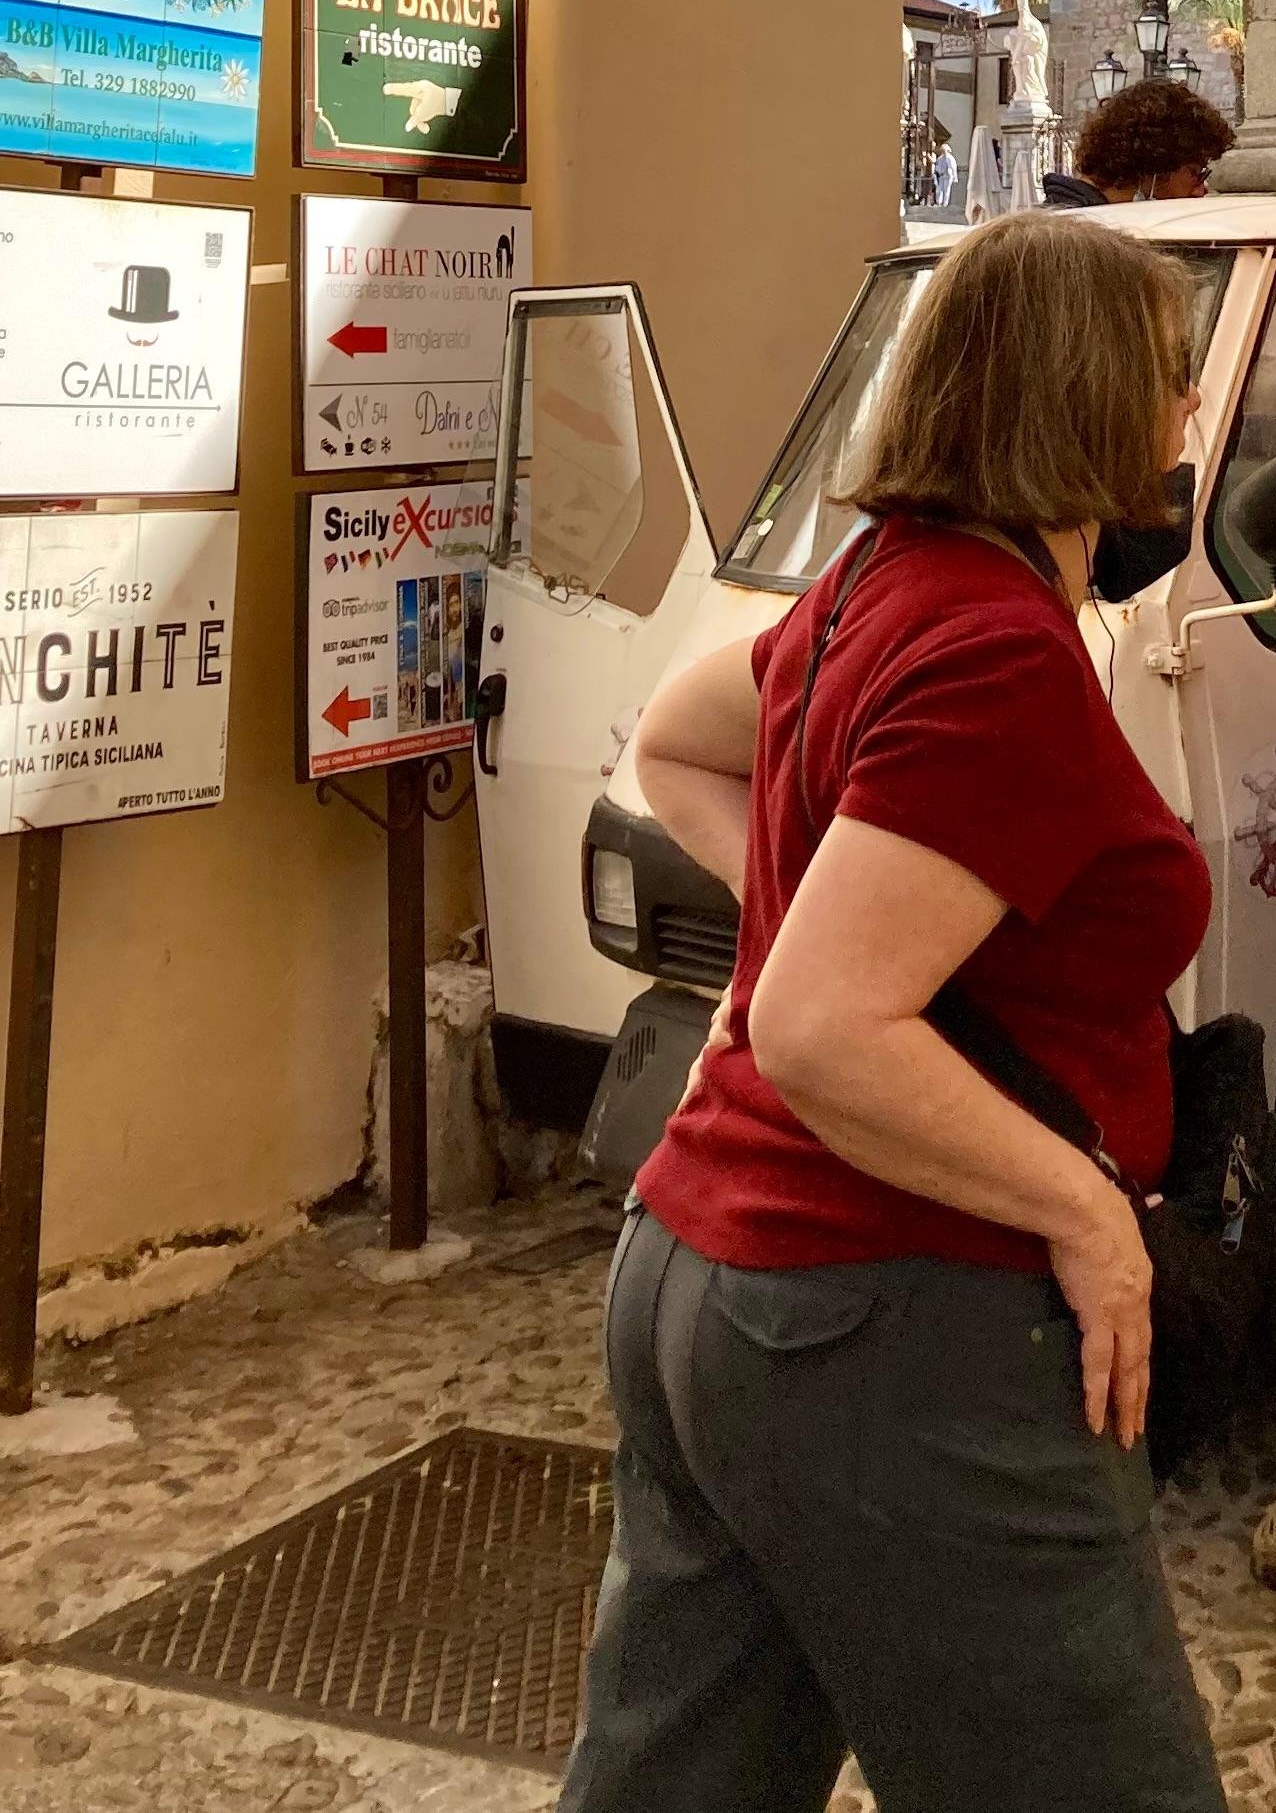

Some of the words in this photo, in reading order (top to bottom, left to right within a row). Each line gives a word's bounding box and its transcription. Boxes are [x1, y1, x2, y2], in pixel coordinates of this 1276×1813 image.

[7, 16, 54, 48] B&B
[61, 25, 109, 57] Villa
[115, 33, 224, 72] Margherita
[358, 22, 483, 69] ristorante
[61, 68, 89, 88] Tel.
[94, 72, 125, 93] 329
[130, 77, 196, 102] 1882990
[0, 109, 199, 148] ww.villamargheritacefalu.it
[325, 245, 357, 275] LE
[365, 247, 428, 277] CHAT
[435, 250, 492, 279] NOIR
[61, 361, 213, 400] GALLERIA
[75, 411, 196, 429] ristorante
[323, 506, 390, 542] Sicily
[4, 587, 64, 612] SERIO
[109, 582, 153, 604] 1952
[341, 599, 390, 618] tripadvisor
[322, 641, 339, 653] BEST
[340, 637, 368, 650] QUALITY
[370, 634, 389, 645] PRICE
[336, 654, 356, 666] SINCE
[26, 715, 119, 745] TAVERNA
[41, 751, 89, 772] TIPICA
[94, 742, 164, 766] SICILIANA
[117, 792, 153, 809] APERTO
[155, 788, 186, 805] TUTTO
[188, 785, 221, 801] L'ANNO
